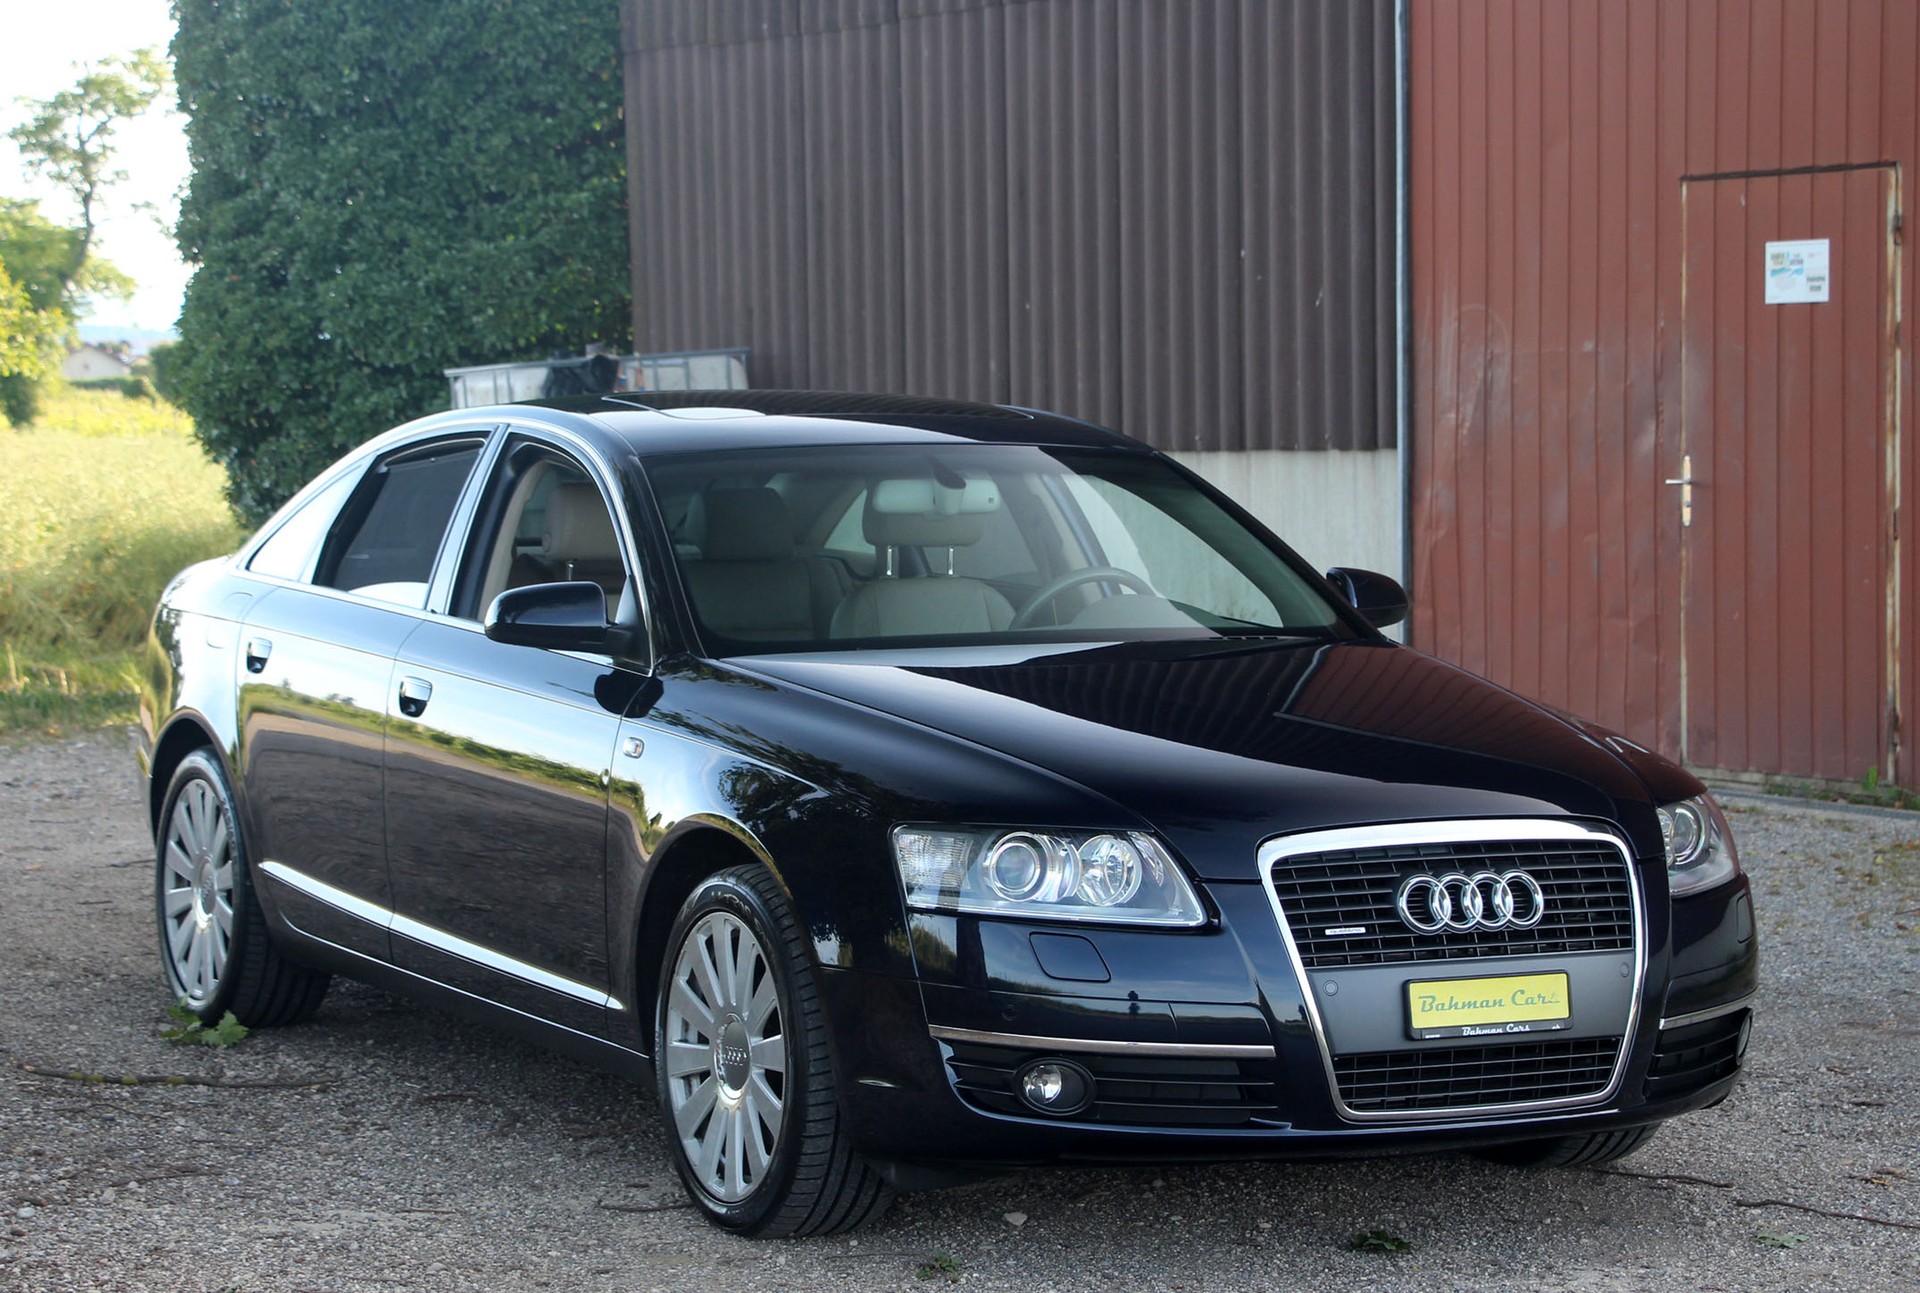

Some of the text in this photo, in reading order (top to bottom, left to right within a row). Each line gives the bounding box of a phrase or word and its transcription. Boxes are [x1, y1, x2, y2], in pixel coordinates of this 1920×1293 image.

[1418, 995, 1506, 1013] Bahman
[1461, 1026, 1503, 1036] Bahman
[1506, 1023, 1531, 1034] Cars
